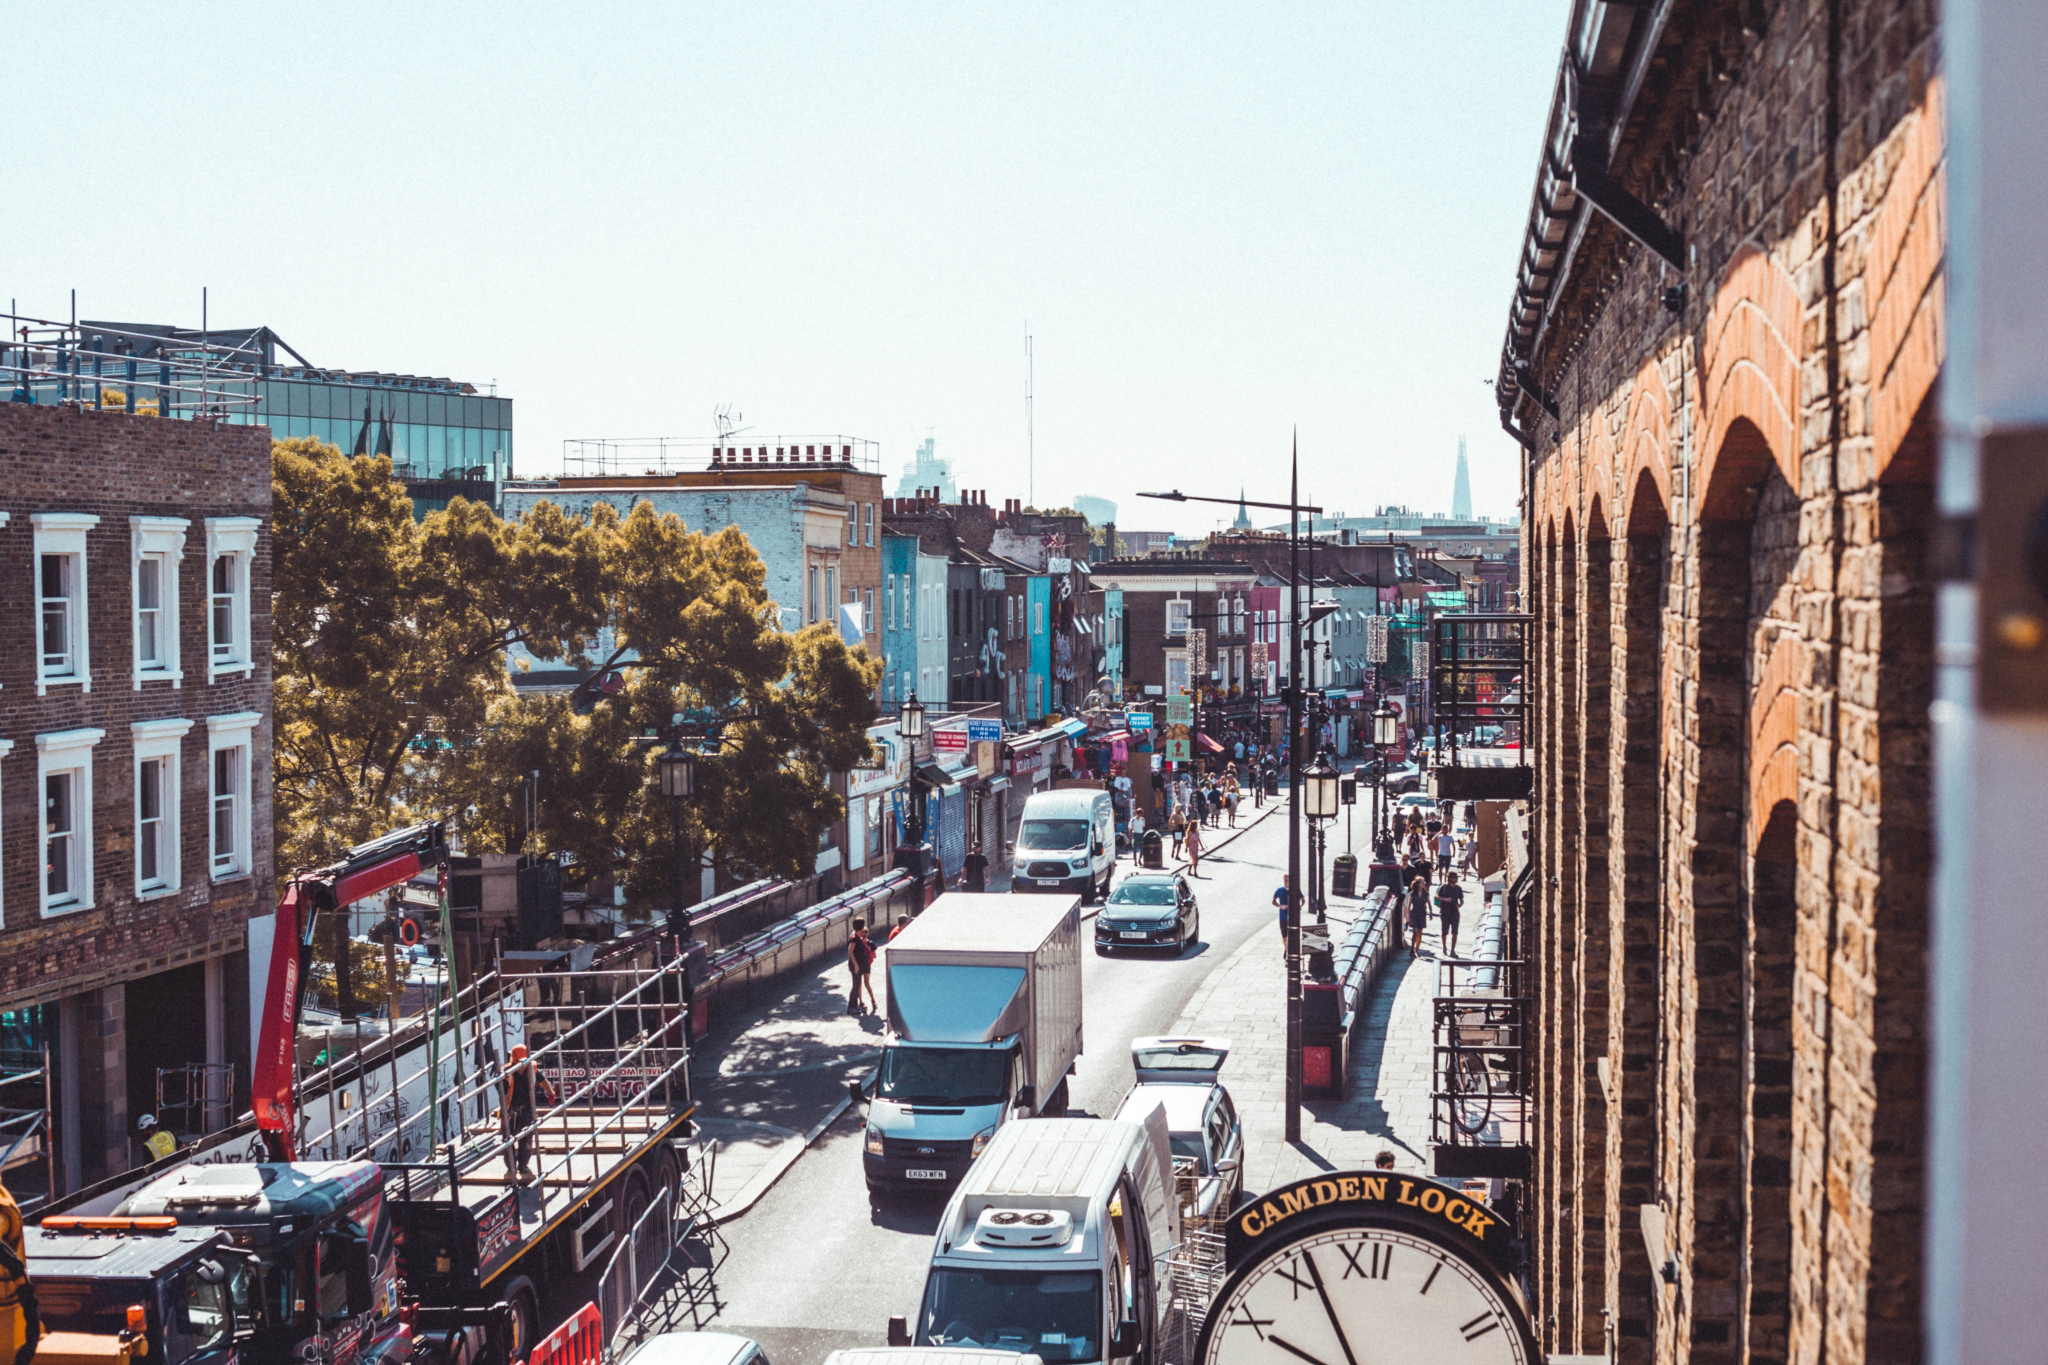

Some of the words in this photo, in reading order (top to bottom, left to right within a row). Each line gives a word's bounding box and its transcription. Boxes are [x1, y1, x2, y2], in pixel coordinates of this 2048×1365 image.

[284, 962, 295, 1018] FASSI
[639, 1067, 661, 1076] MEN
[908, 1170, 928, 1178] EK63
[1241, 1177, 1388, 1237] CAMDEN
[1397, 1180, 1495, 1241] LOCK
[1337, 1242, 1393, 1280] XII
[1419, 1262, 1442, 1295] I
[1231, 1302, 1275, 1341] X
[1459, 1310, 1499, 1342] II
